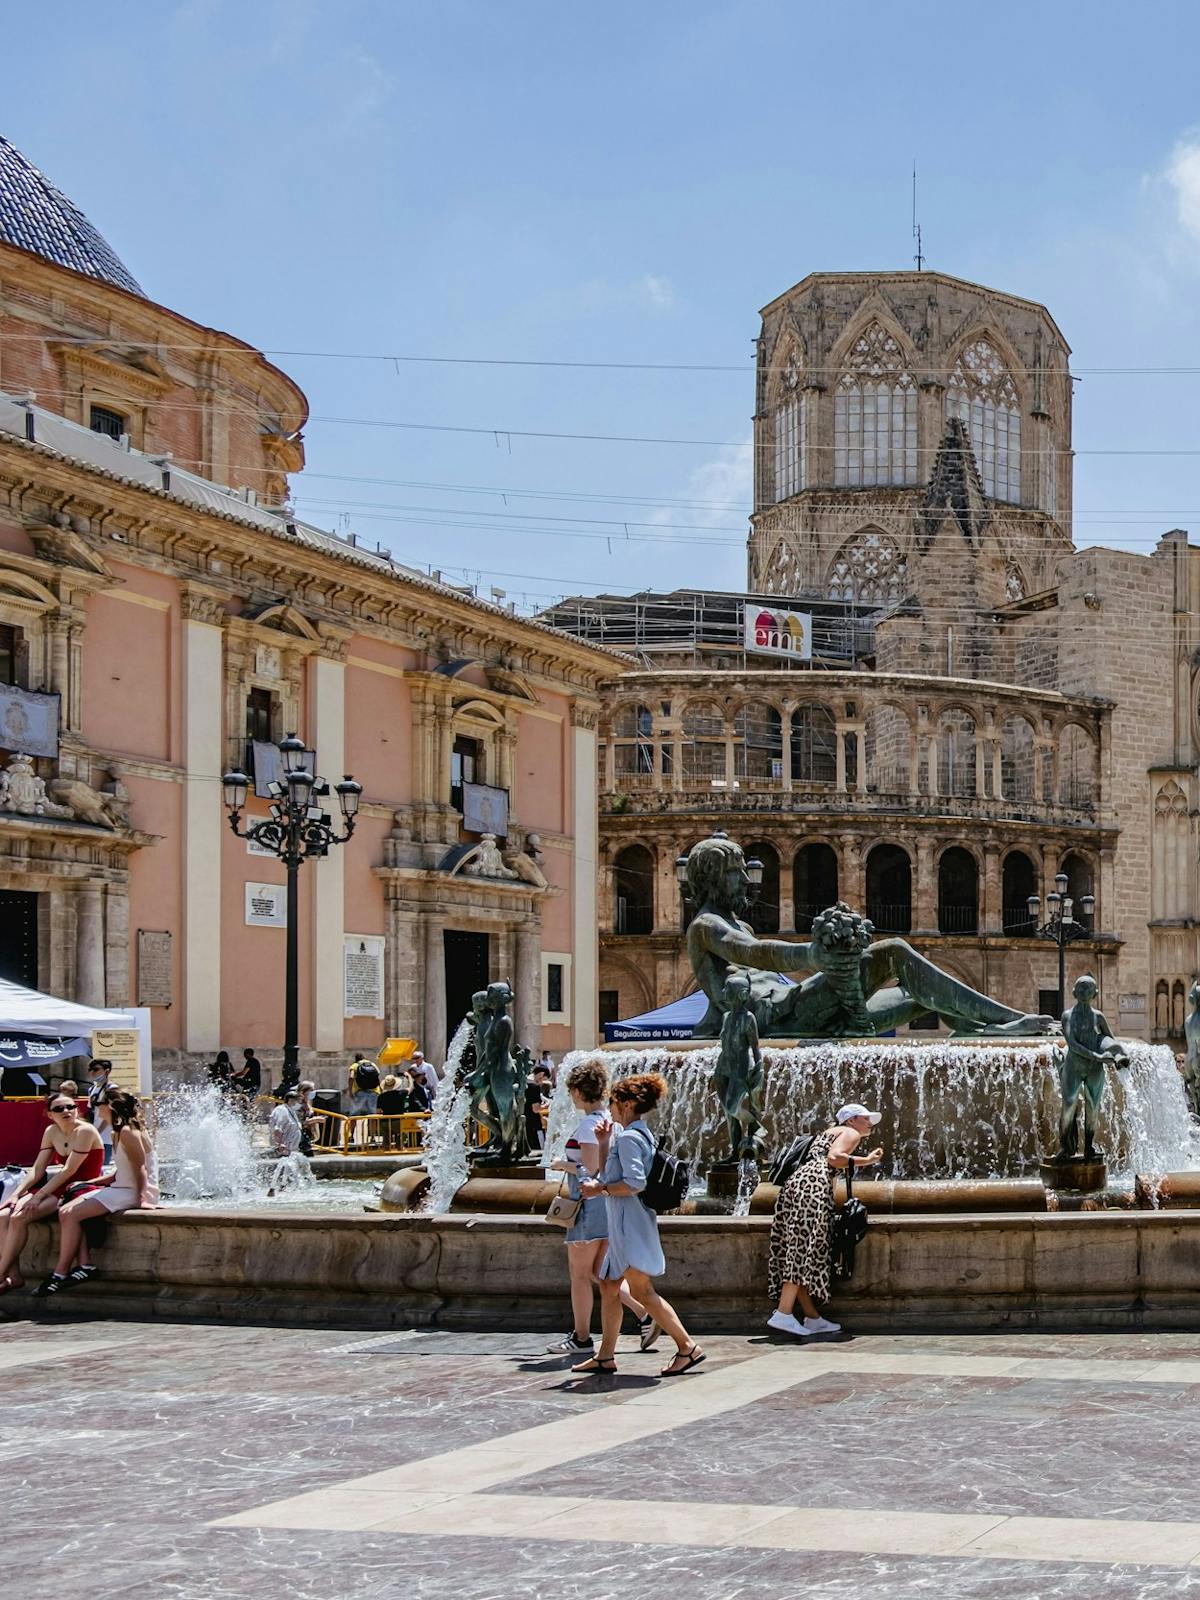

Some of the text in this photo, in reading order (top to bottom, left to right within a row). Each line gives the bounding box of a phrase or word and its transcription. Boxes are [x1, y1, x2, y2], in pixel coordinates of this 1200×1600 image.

[614, 1029, 693, 1039] Seguidores de la Virgen
